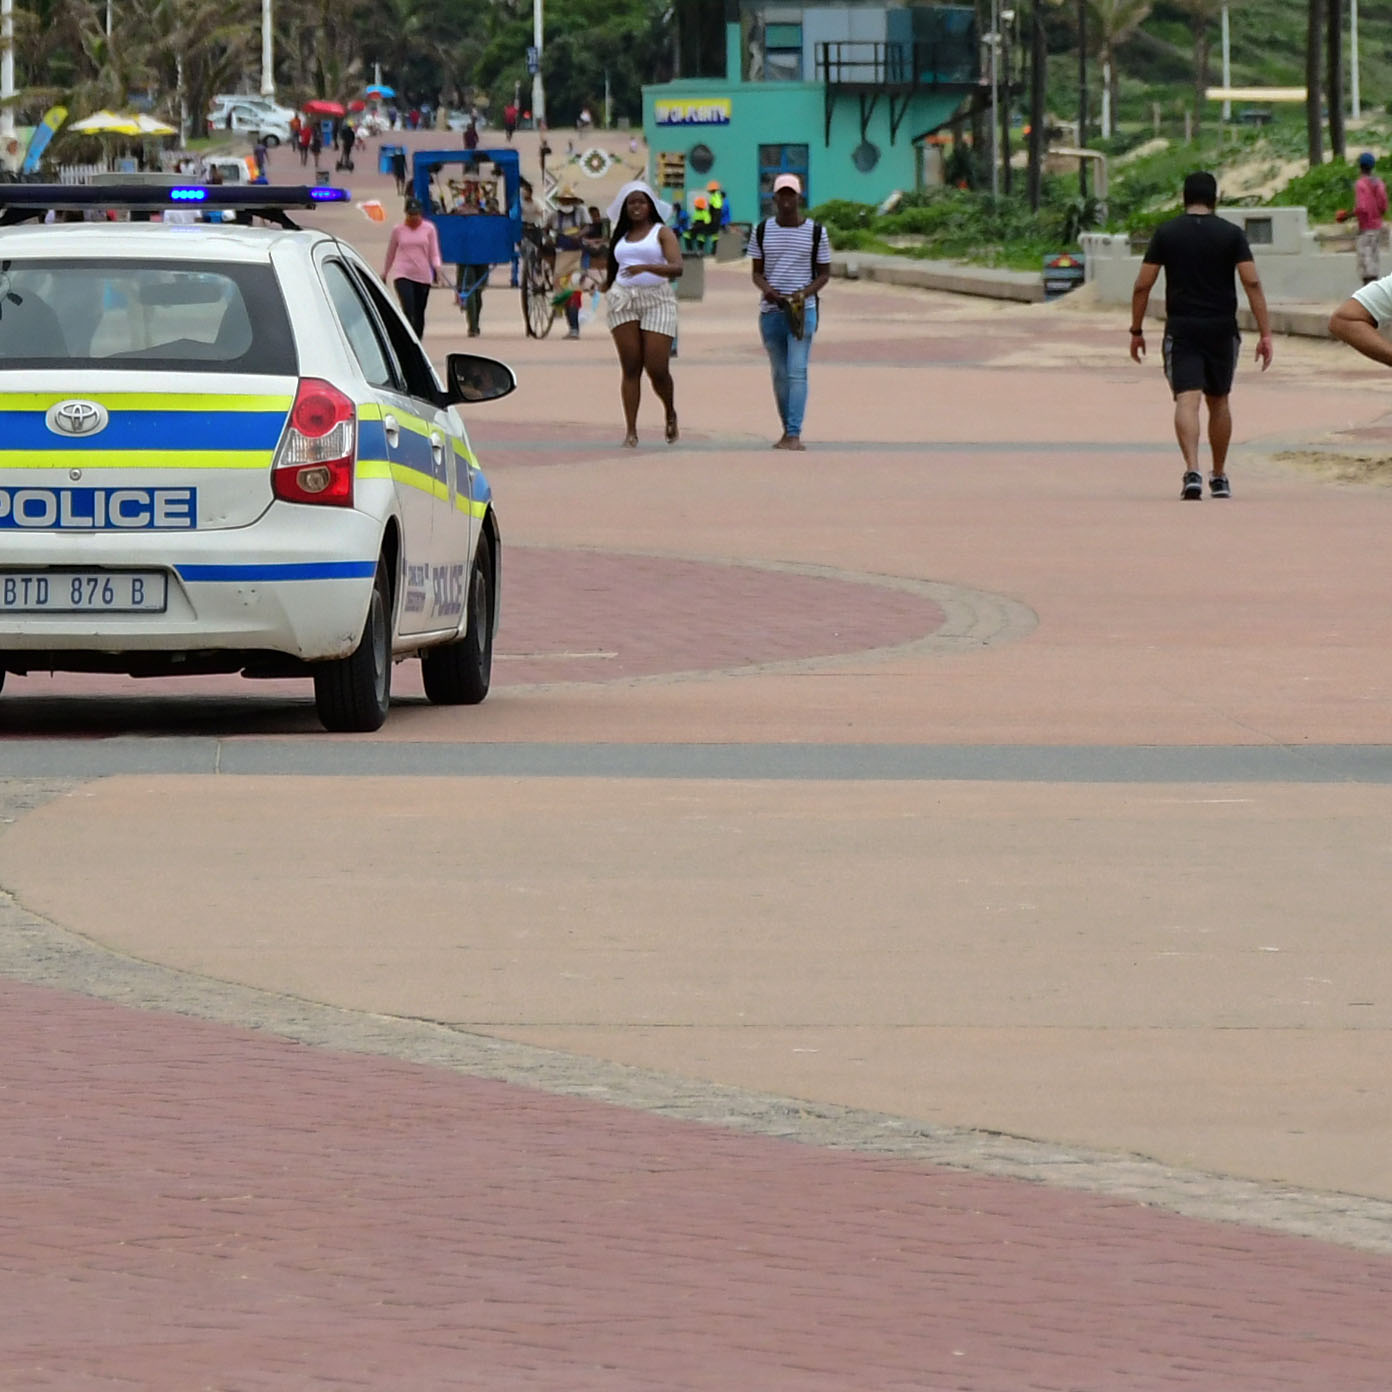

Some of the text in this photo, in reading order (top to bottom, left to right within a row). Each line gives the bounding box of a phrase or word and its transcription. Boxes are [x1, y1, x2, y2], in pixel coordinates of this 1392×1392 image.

[4, 578, 145, 605] BTD 876 B
